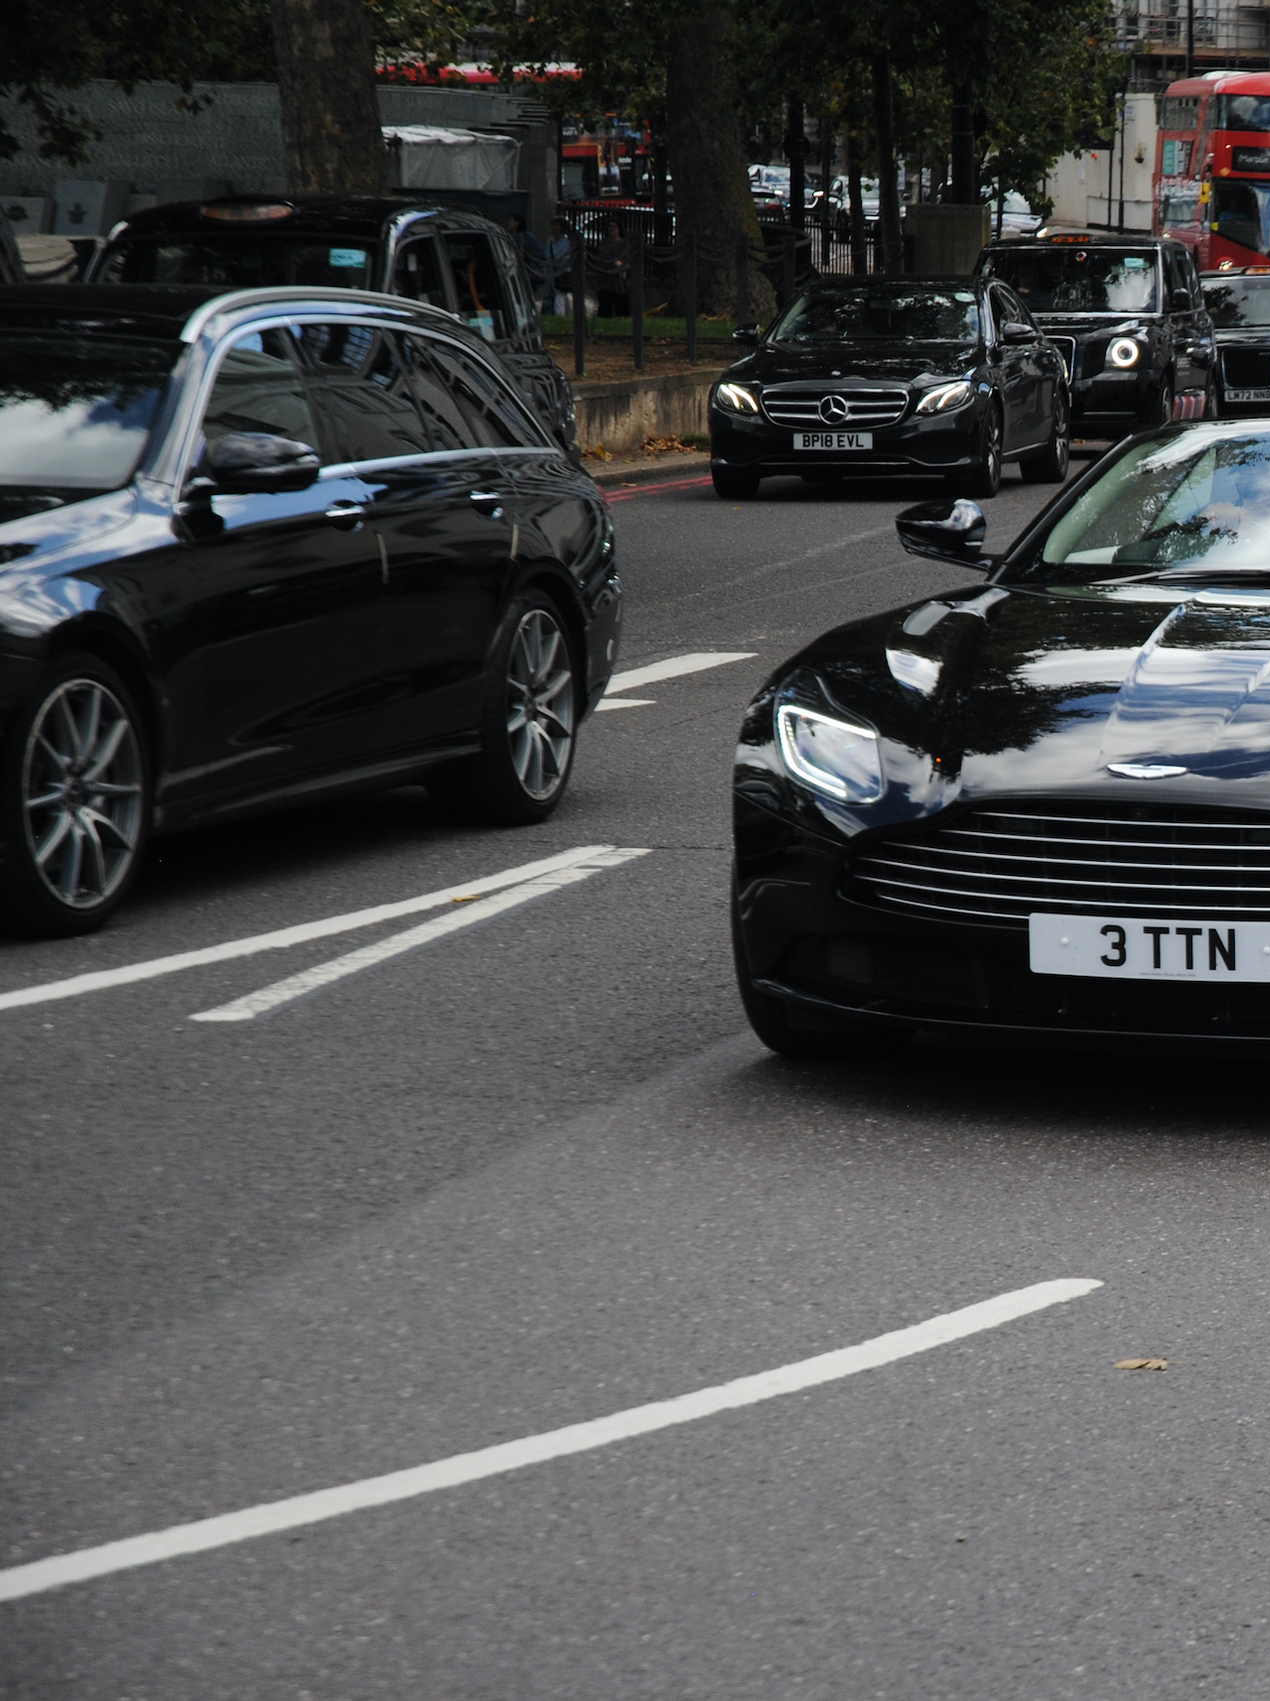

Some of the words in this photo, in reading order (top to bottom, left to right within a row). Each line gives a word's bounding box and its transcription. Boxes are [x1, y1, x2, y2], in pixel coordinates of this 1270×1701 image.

[802, 434, 833, 448] BP18
[837, 434, 864, 448] EVL
[1100, 924, 1126, 967] 3
[1143, 925, 1236, 971] TTN
